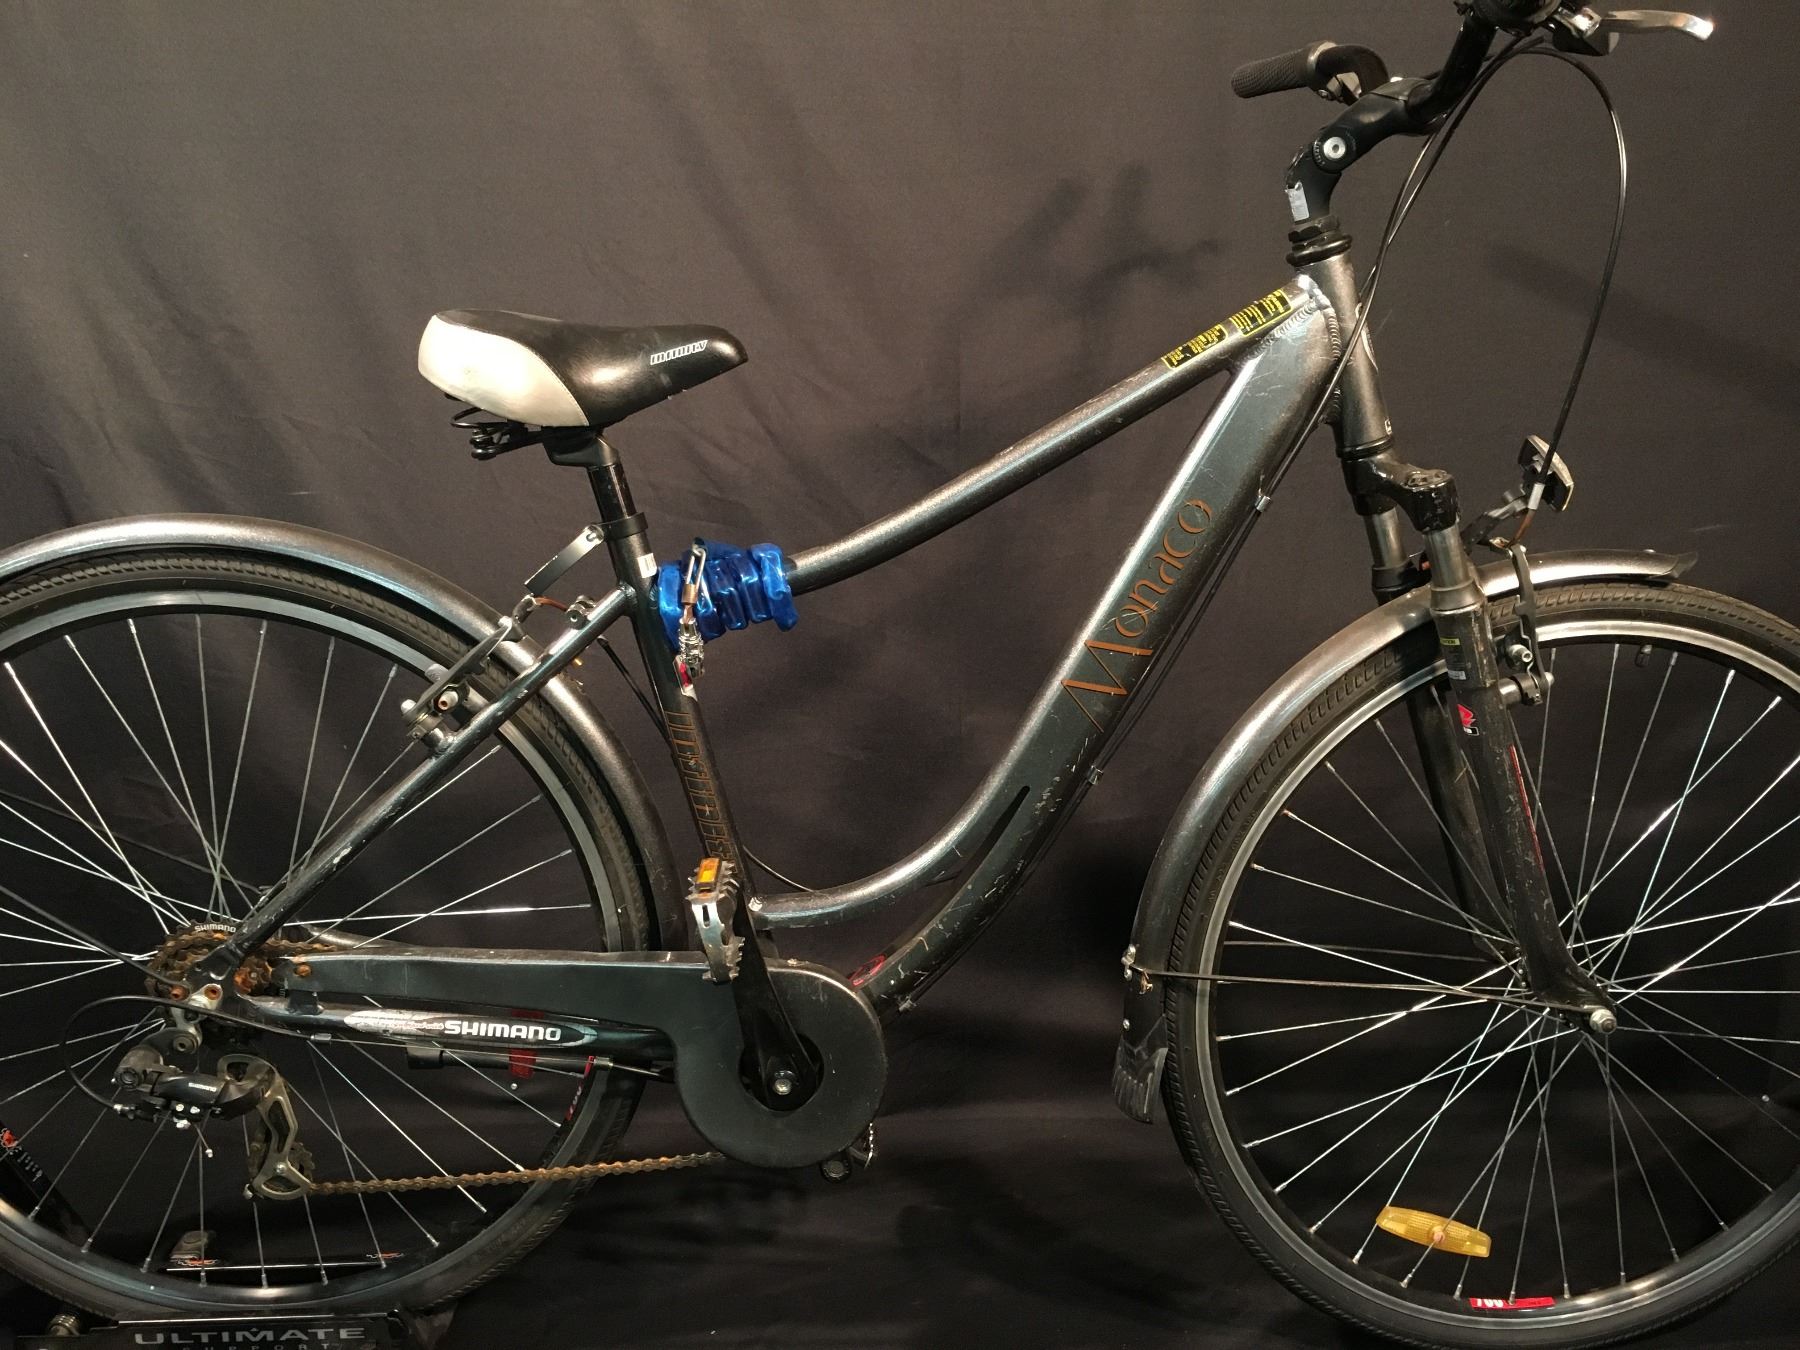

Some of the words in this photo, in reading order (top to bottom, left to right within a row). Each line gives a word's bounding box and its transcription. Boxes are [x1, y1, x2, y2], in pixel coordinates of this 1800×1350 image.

[1060, 499, 1213, 733] Monaco
[194, 923, 237, 933] SHIMANO
[444, 1020, 562, 1041] SHIMANO
[134, 1328, 366, 1345] ULTIMATE
